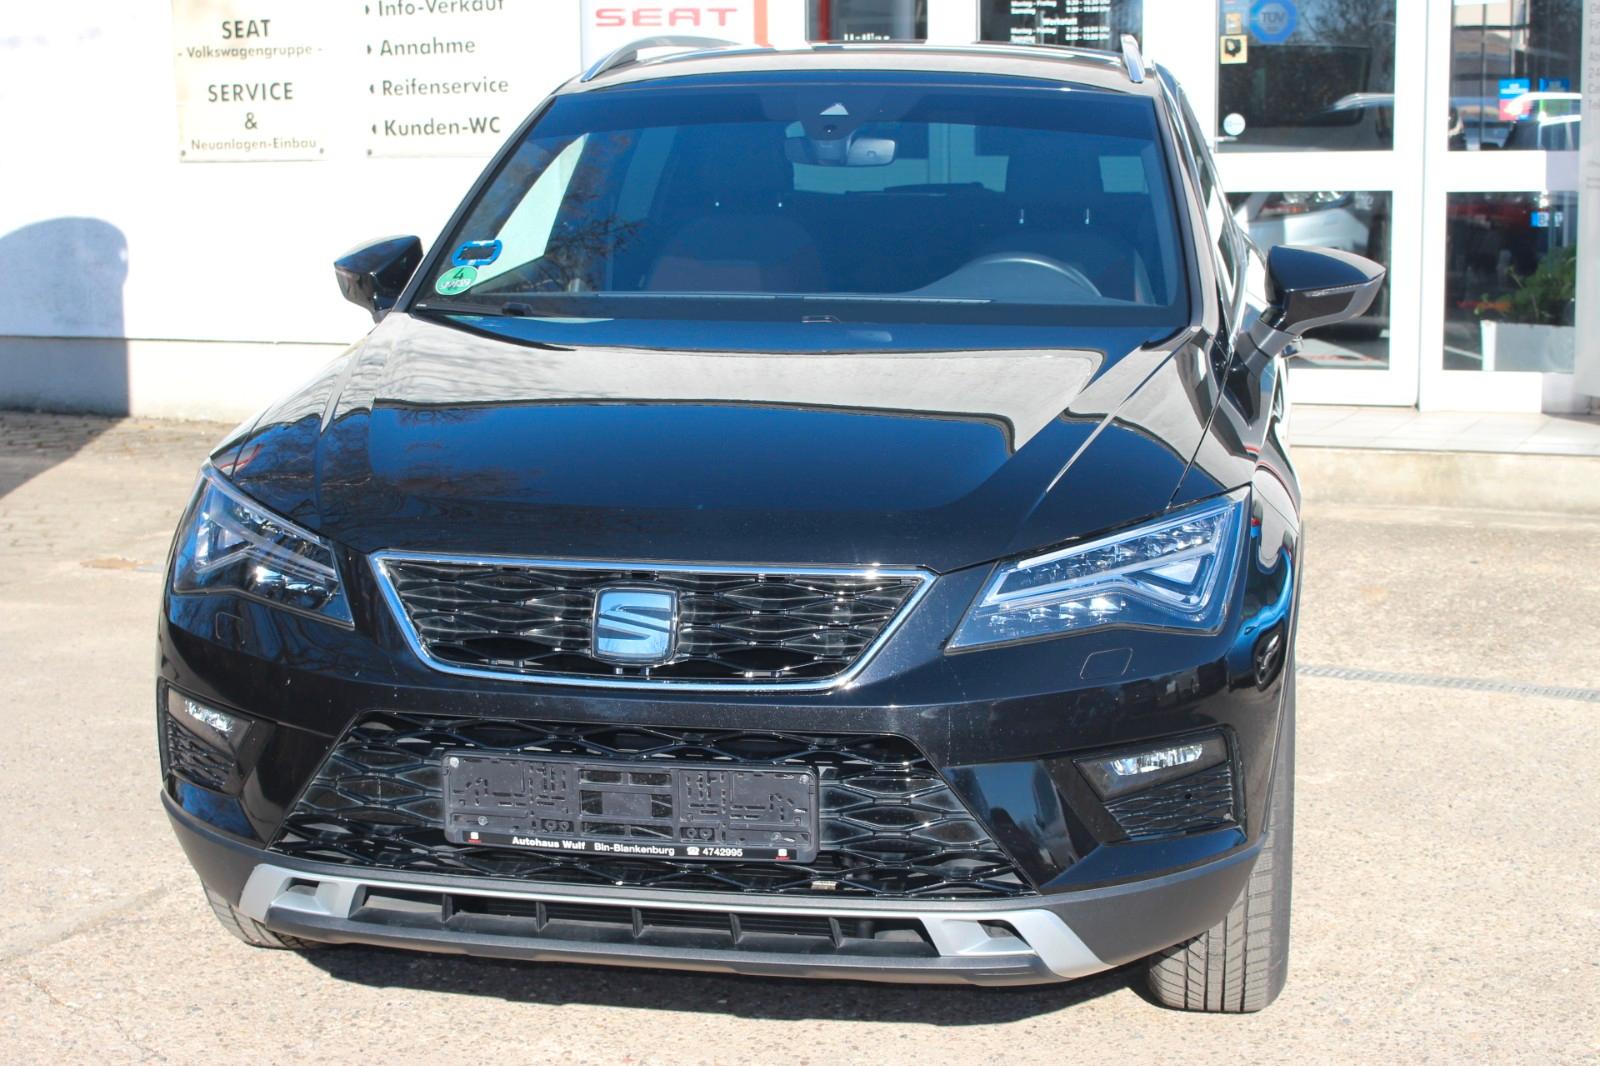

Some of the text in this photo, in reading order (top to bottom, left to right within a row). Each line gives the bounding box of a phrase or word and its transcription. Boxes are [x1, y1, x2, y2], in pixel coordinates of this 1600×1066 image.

[595, 8, 738, 26] SEAT
[221, 19, 271, 39] SEAT
[186, 44, 313, 60] Volkswagengruppe
[380, 37, 476, 56] Annahme
[208, 82, 294, 103] SERVICE
[382, 76, 510, 96] Reifenservice
[244, 112, 258, 130] &
[384, 117, 501, 137] Kunden-WC
[190, 138, 317, 153] Neuanlagen-Einbau
[512, 836, 560, 848] Autohaus
[562, 839, 586, 850] Wulf
[702, 847, 743, 857] 4742995
